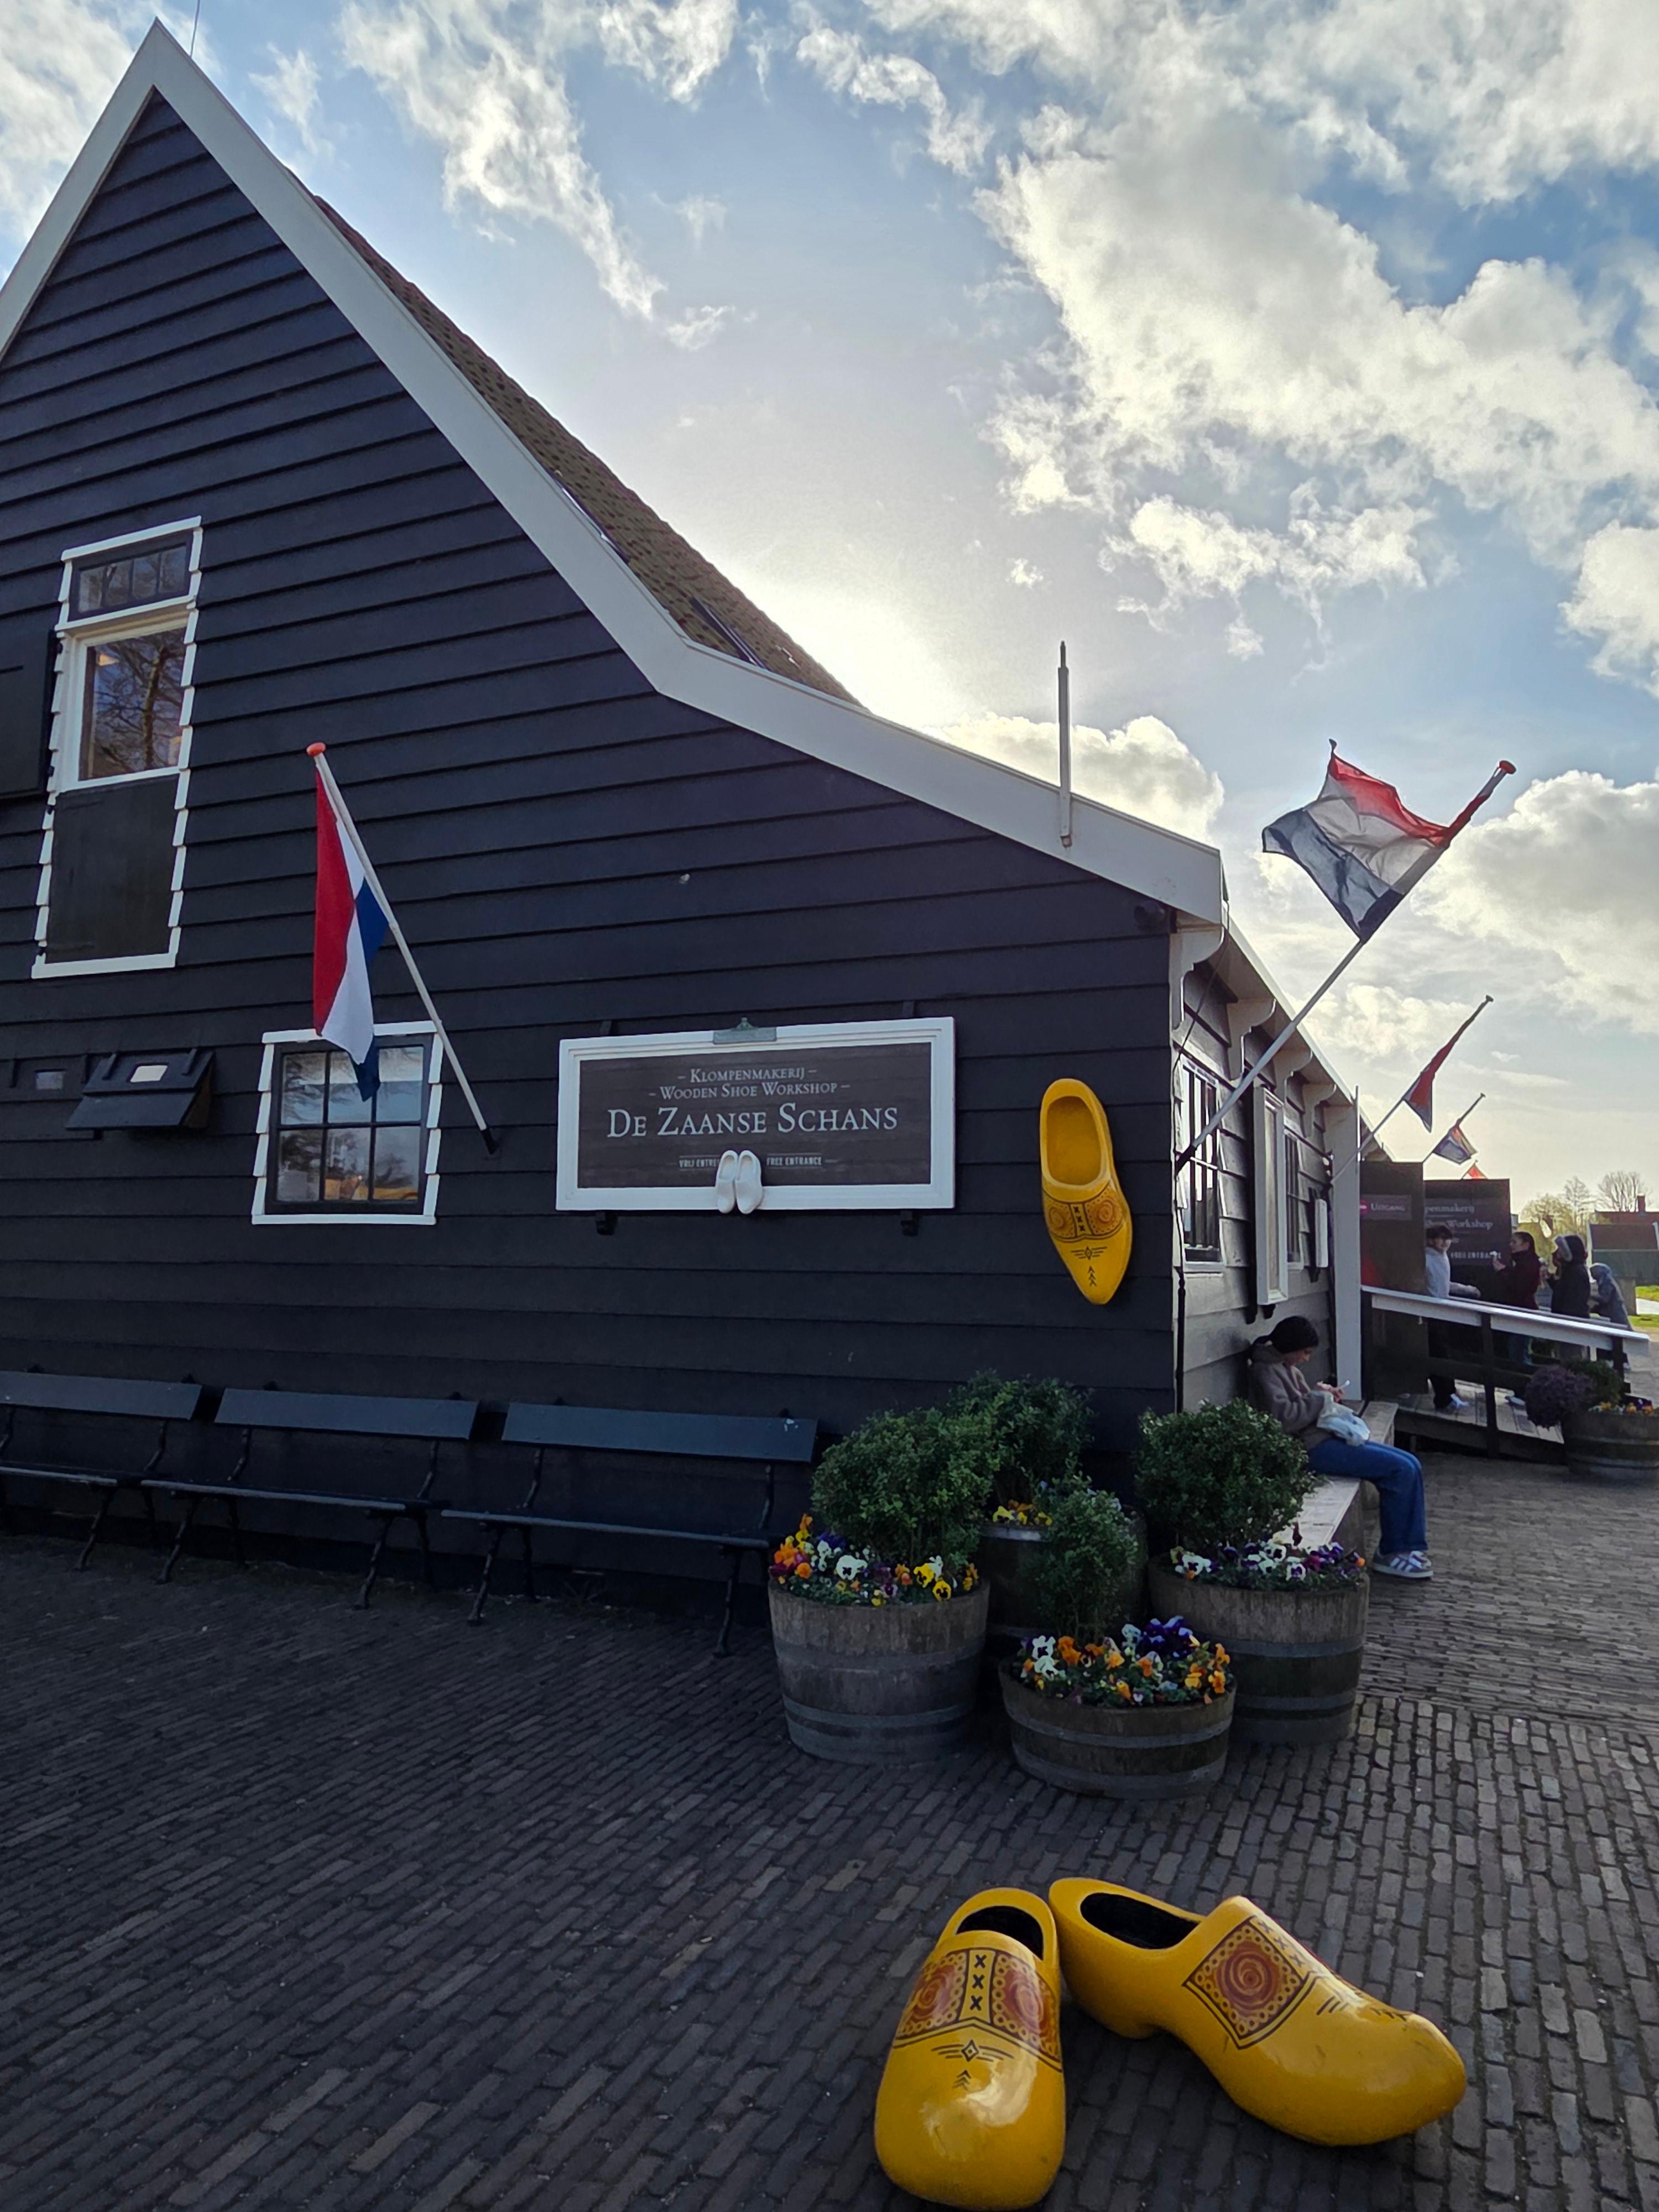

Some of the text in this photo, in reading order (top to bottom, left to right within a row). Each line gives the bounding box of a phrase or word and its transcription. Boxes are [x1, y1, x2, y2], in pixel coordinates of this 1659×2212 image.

[690, 1067, 805, 1083] KLOMPENMAKERIJ
[660, 1081, 837, 1100] WOODEN SHOE WORKSHOP
[607, 1102, 898, 1138] DE ZAANSE SCHANS
[766, 1157, 782, 1166] FREE
[785, 1156, 822, 1165] ENTRANCE
